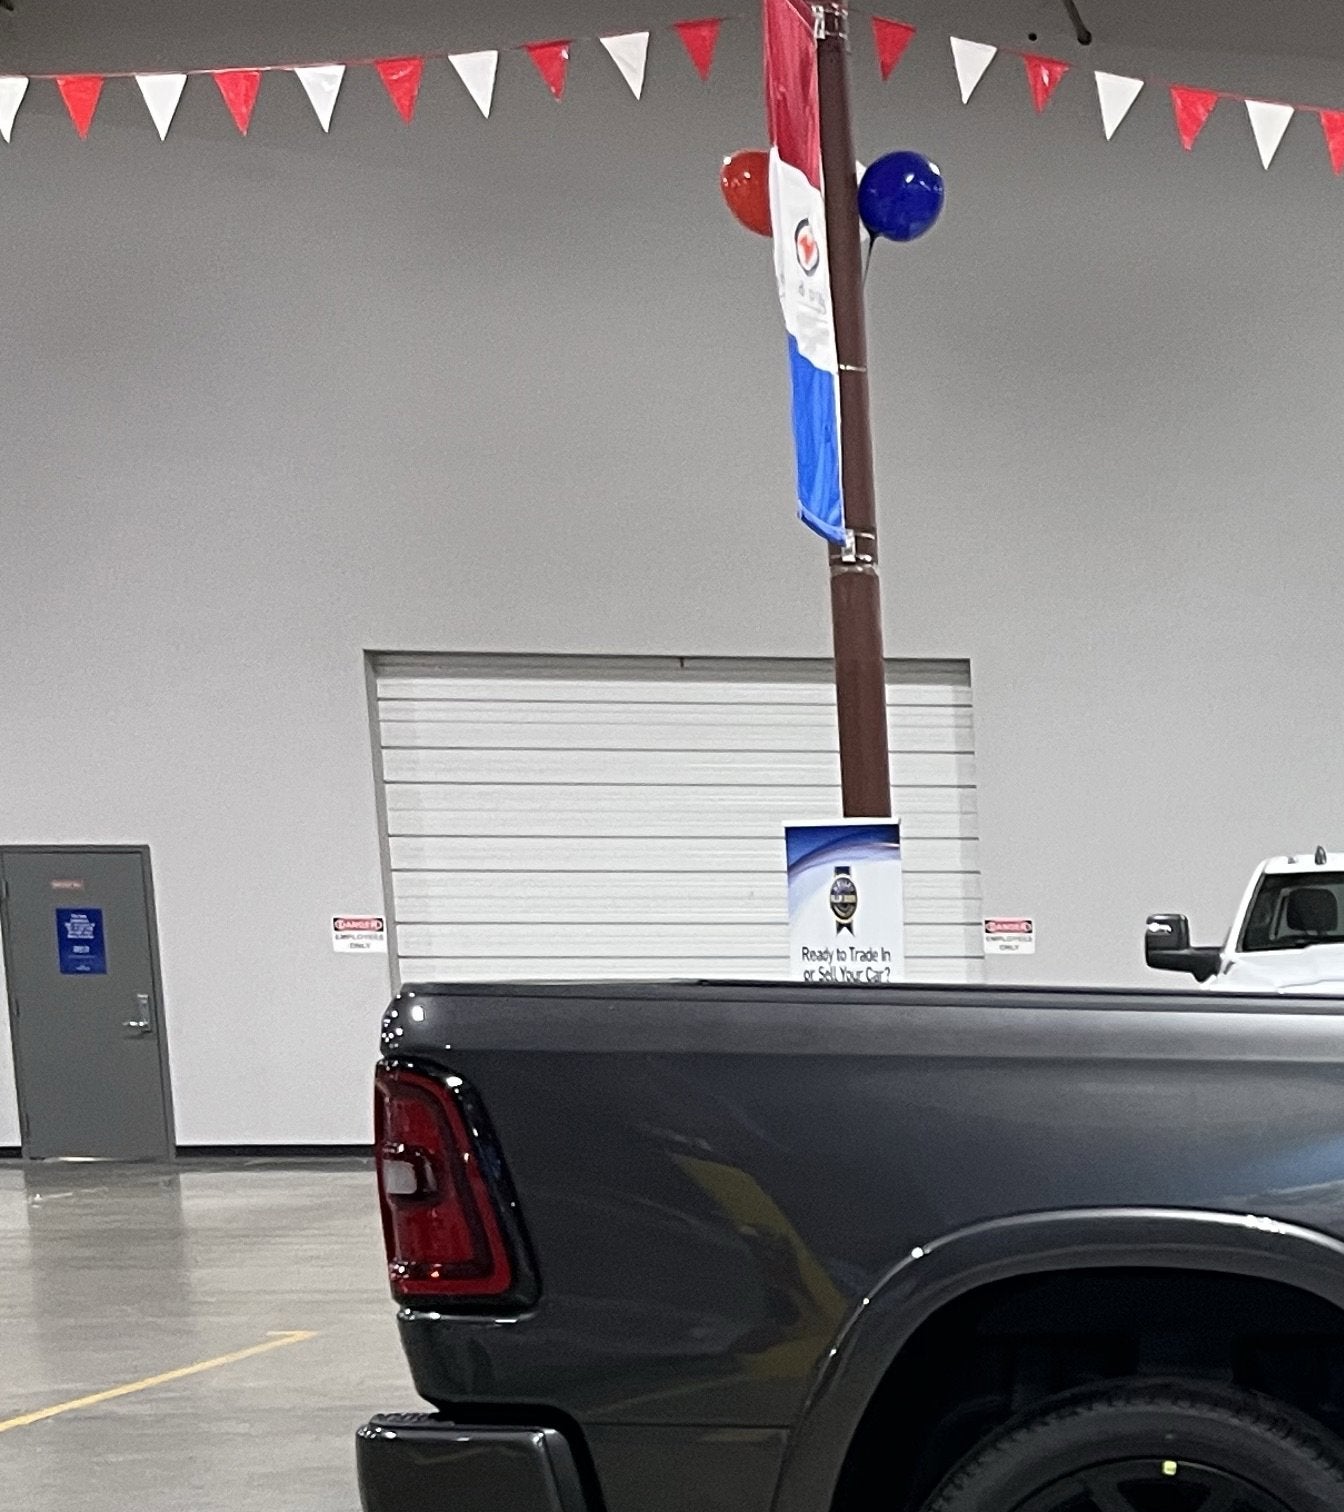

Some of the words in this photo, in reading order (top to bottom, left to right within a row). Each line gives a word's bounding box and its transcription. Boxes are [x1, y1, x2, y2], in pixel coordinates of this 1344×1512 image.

[802, 946, 834, 964] Ready
[836, 947, 847, 961] to
[849, 946, 879, 962] Trade
[881, 946, 891, 962] In
